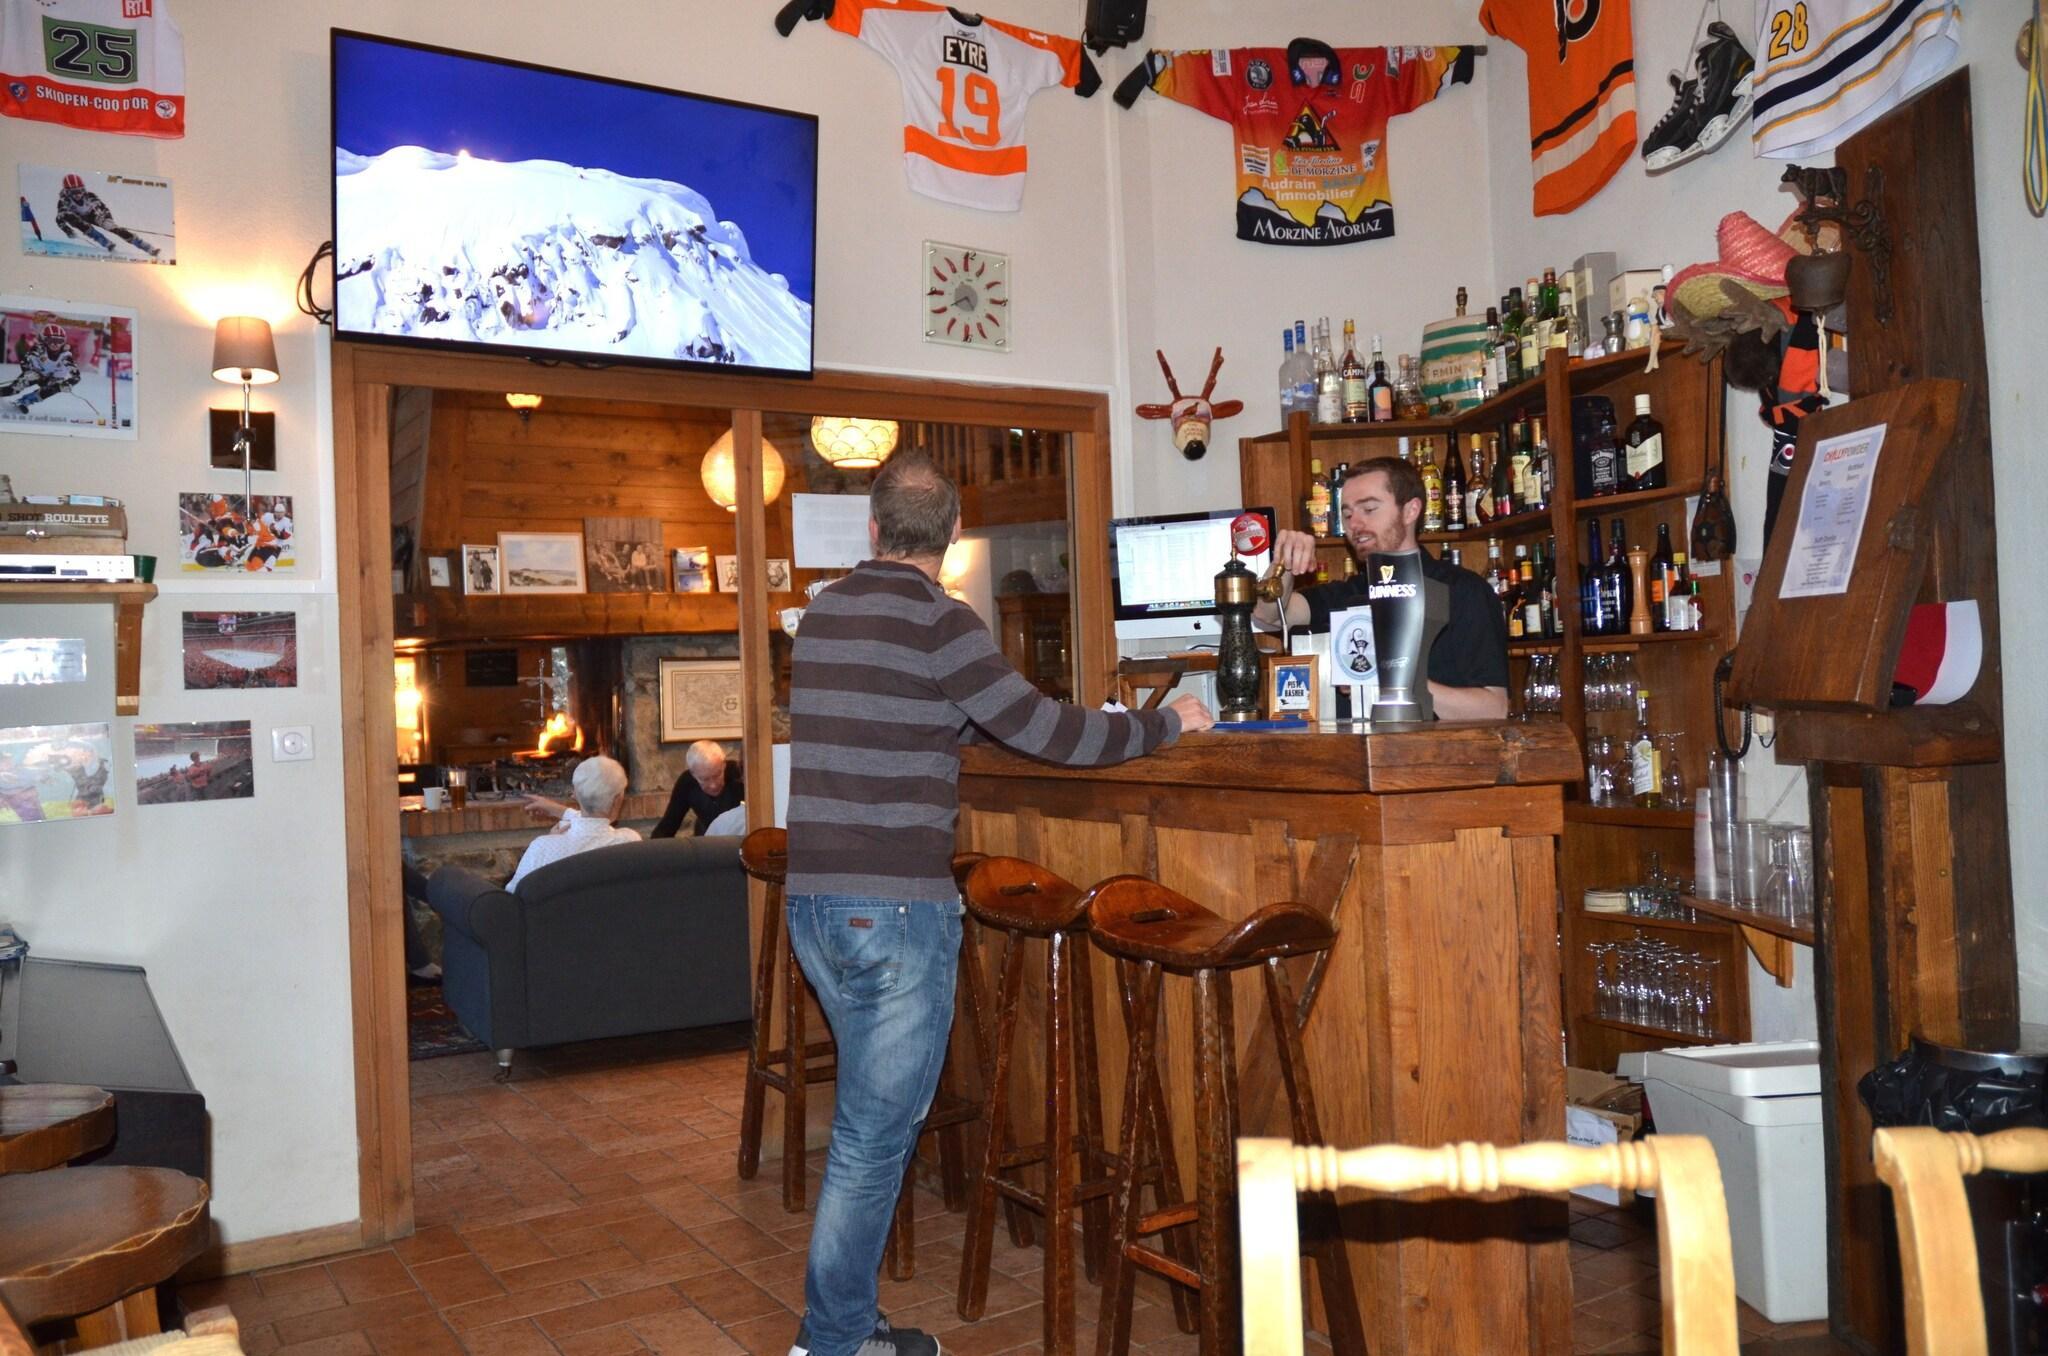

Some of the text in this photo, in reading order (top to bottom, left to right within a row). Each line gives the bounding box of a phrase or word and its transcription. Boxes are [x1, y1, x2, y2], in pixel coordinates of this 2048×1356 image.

[1768, 2, 1809, 62] 28
[51, 26, 133, 78] 25
[945, 37, 987, 70] EYRE
[936, 66, 1002, 147] 19
[1307, 165, 1356, 176] MORZINE
[1263, 178, 1316, 190] Audrain
[1276, 188, 1356, 201] Immobilier
[1253, 218, 1382, 241] MORZINE AVORIAZ
[8, 512, 109, 524] SHOT ROULETTE
[1368, 584, 1417, 599] GUINNESS
